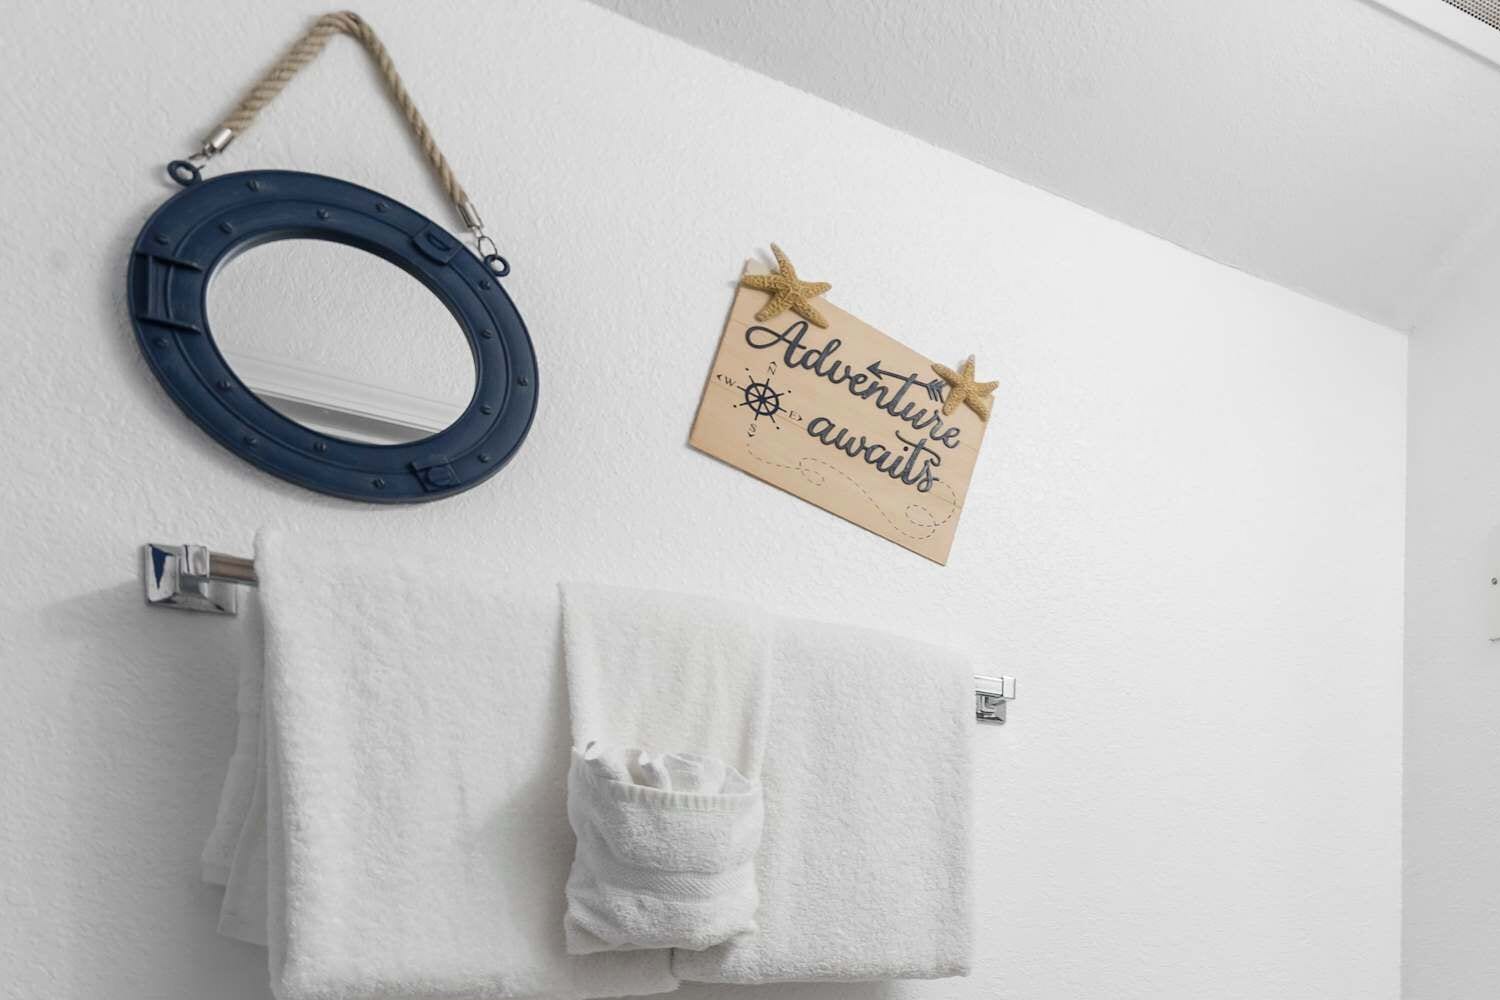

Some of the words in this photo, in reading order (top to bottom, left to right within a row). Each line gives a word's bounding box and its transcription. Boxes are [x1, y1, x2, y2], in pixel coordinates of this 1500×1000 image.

[767, 365, 778, 376] N
[724, 376, 736, 387] W
[745, 321, 960, 448] Adventure
[788, 410, 797, 420] E
[748, 423, 757, 433] S
[806, 416, 941, 493] awaits
